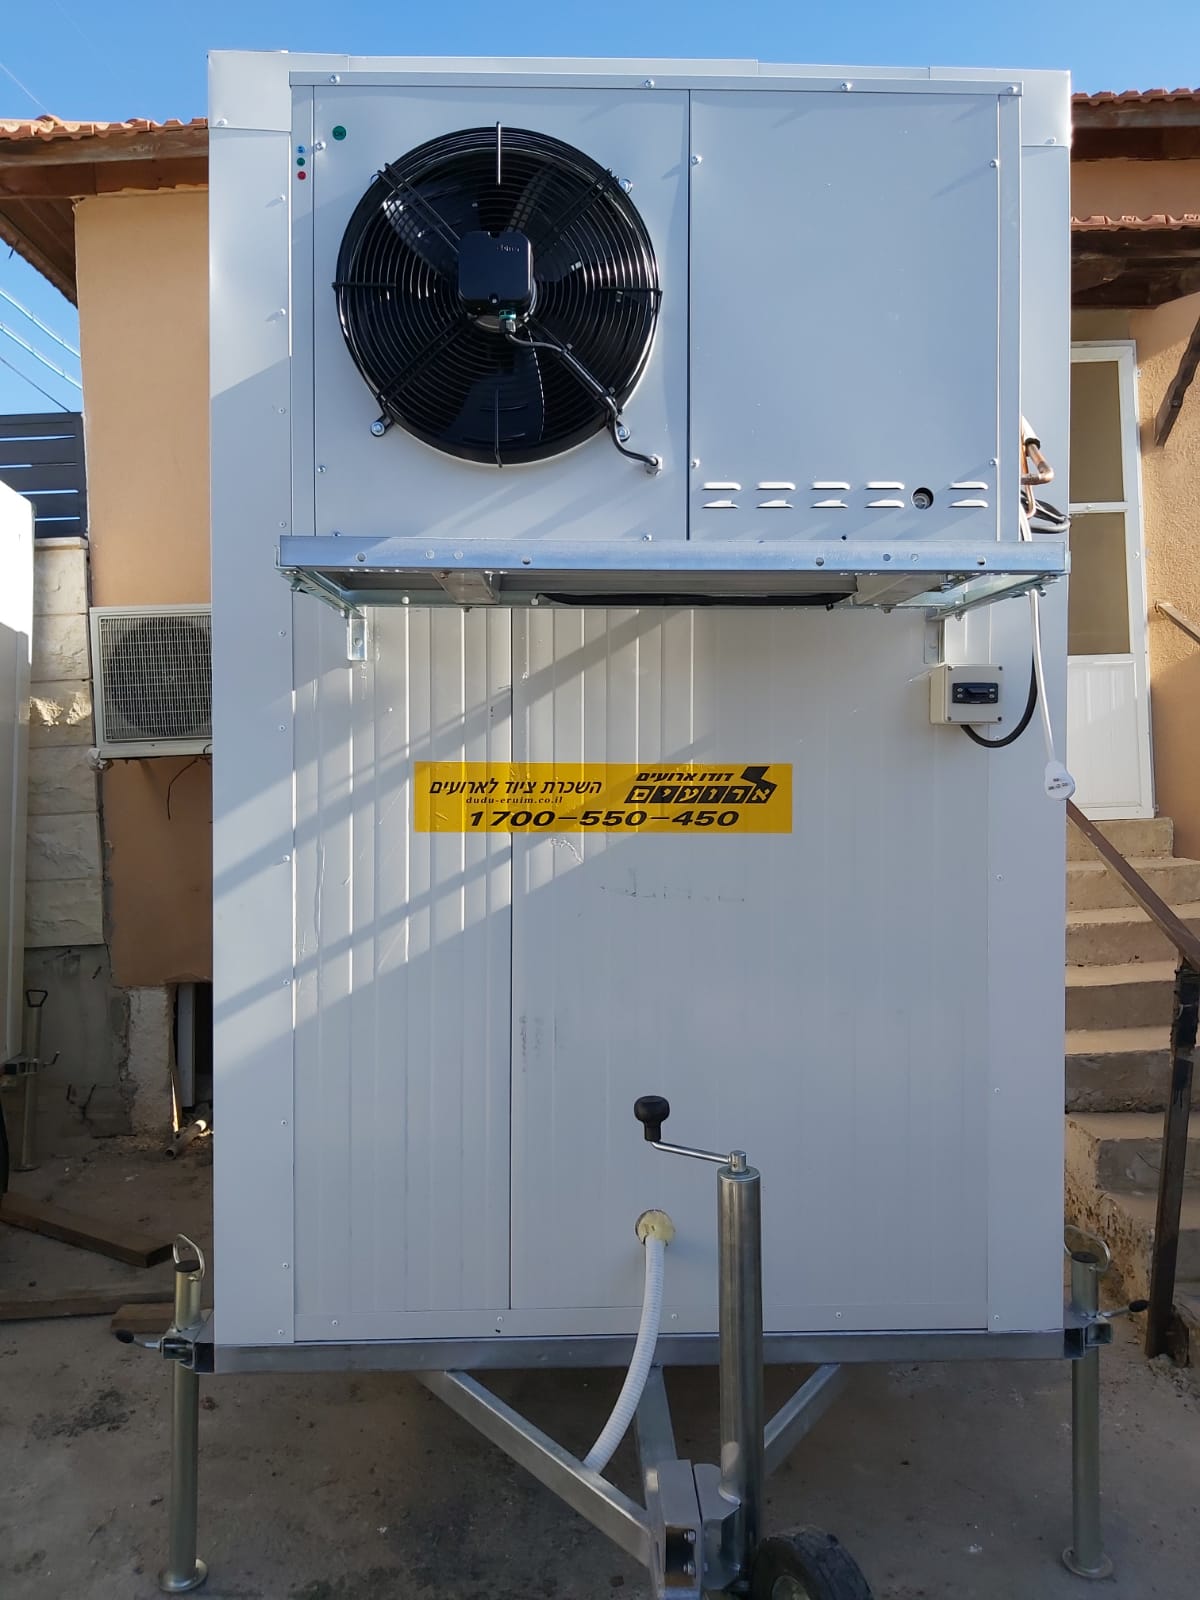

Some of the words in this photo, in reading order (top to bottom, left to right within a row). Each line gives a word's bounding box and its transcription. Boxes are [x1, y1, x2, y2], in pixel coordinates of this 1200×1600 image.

[636, 772, 695, 783] ארועים
[700, 772, 735, 782] דודו
[429, 778, 499, 795] לארועים
[505, 781, 537, 794] ציוד
[541, 781, 602, 794] השכרת
[466, 796, 563, 804] dudu-eruim.co.il
[625, 786, 774, 803] ארועים
